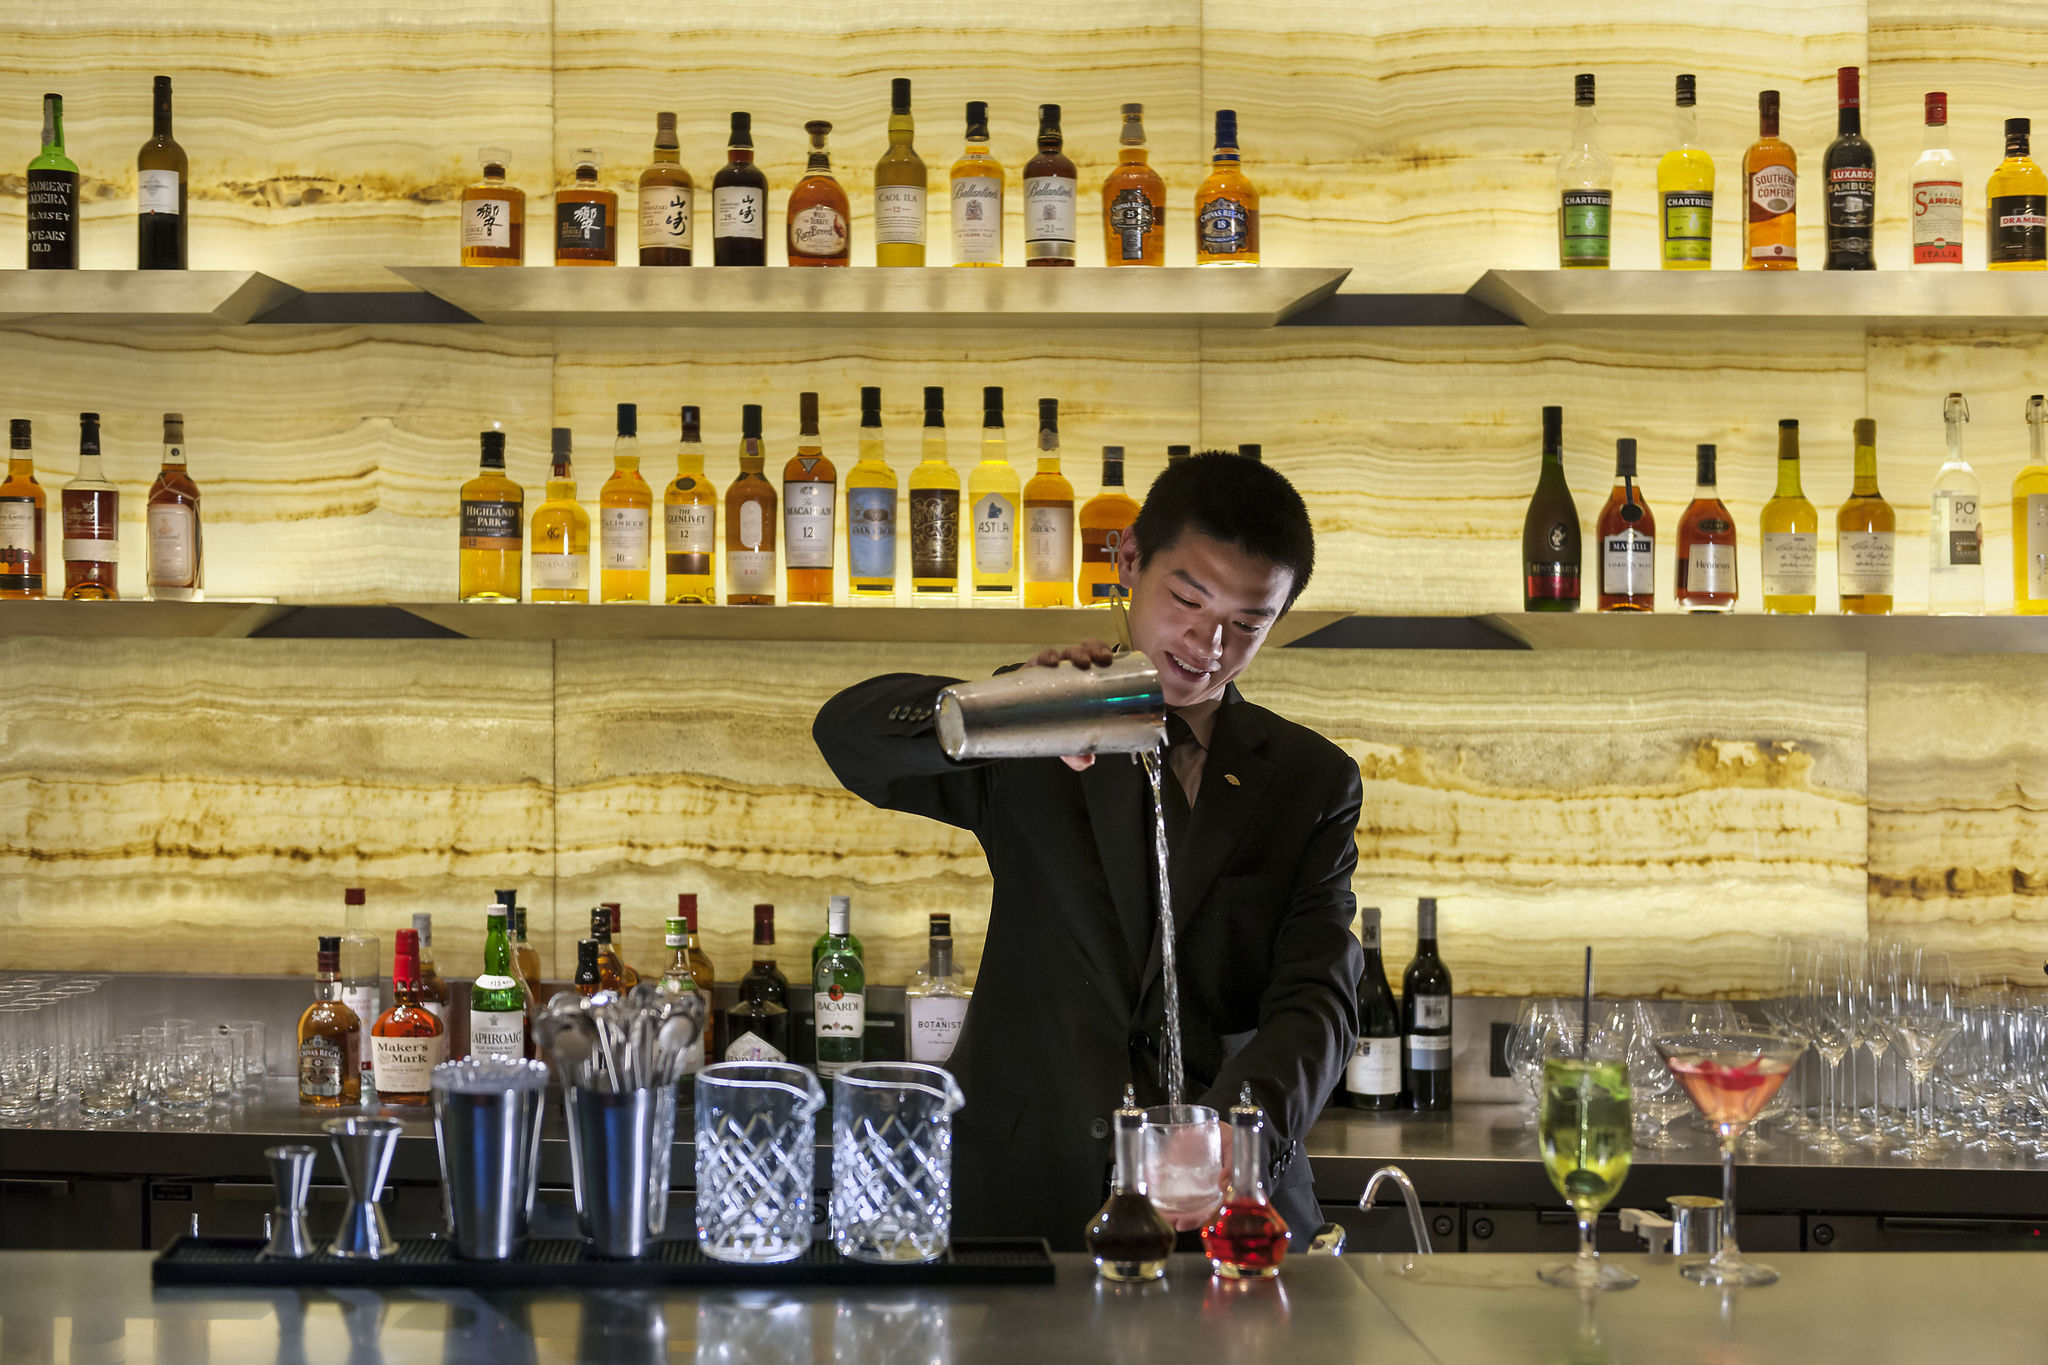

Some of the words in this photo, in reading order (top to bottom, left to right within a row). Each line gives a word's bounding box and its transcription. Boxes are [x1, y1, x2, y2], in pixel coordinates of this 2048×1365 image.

[1755, 173, 1795, 186] SOUTHERN
[1832, 170, 1873, 179] LUXARDO
[878, 193, 901, 203] CAOL
[903, 193, 918, 203] ILA
[1758, 188, 1794, 199] COMFORT
[28, 193, 67, 205] ADEIRA
[1111, 202, 1131, 213] CHIVAS
[1127, 210, 1135, 218] 25
[1200, 210, 1222, 223] CHIVAS
[1223, 210, 1245, 221] REGAL
[1217, 220, 1226, 229] 18
[32, 243, 52, 252] OLD
[1922, 250, 1958, 258] ITALIA
[466, 505, 515, 518] HIGHLAND
[477, 517, 501, 527] PARK
[667, 514, 706, 525] GLENLIVET
[680, 530, 689, 538] 12
[803, 526, 813, 538] 12
[817, 1001, 858, 1011] BACARDI
[918, 1021, 962, 1029] BOTANIST
[377, 1043, 428, 1052] Maker's
[300, 1049, 319, 1058] CHIVAS
[320, 1049, 341, 1058] REGAL
[392, 1054, 427, 1063] Mark
